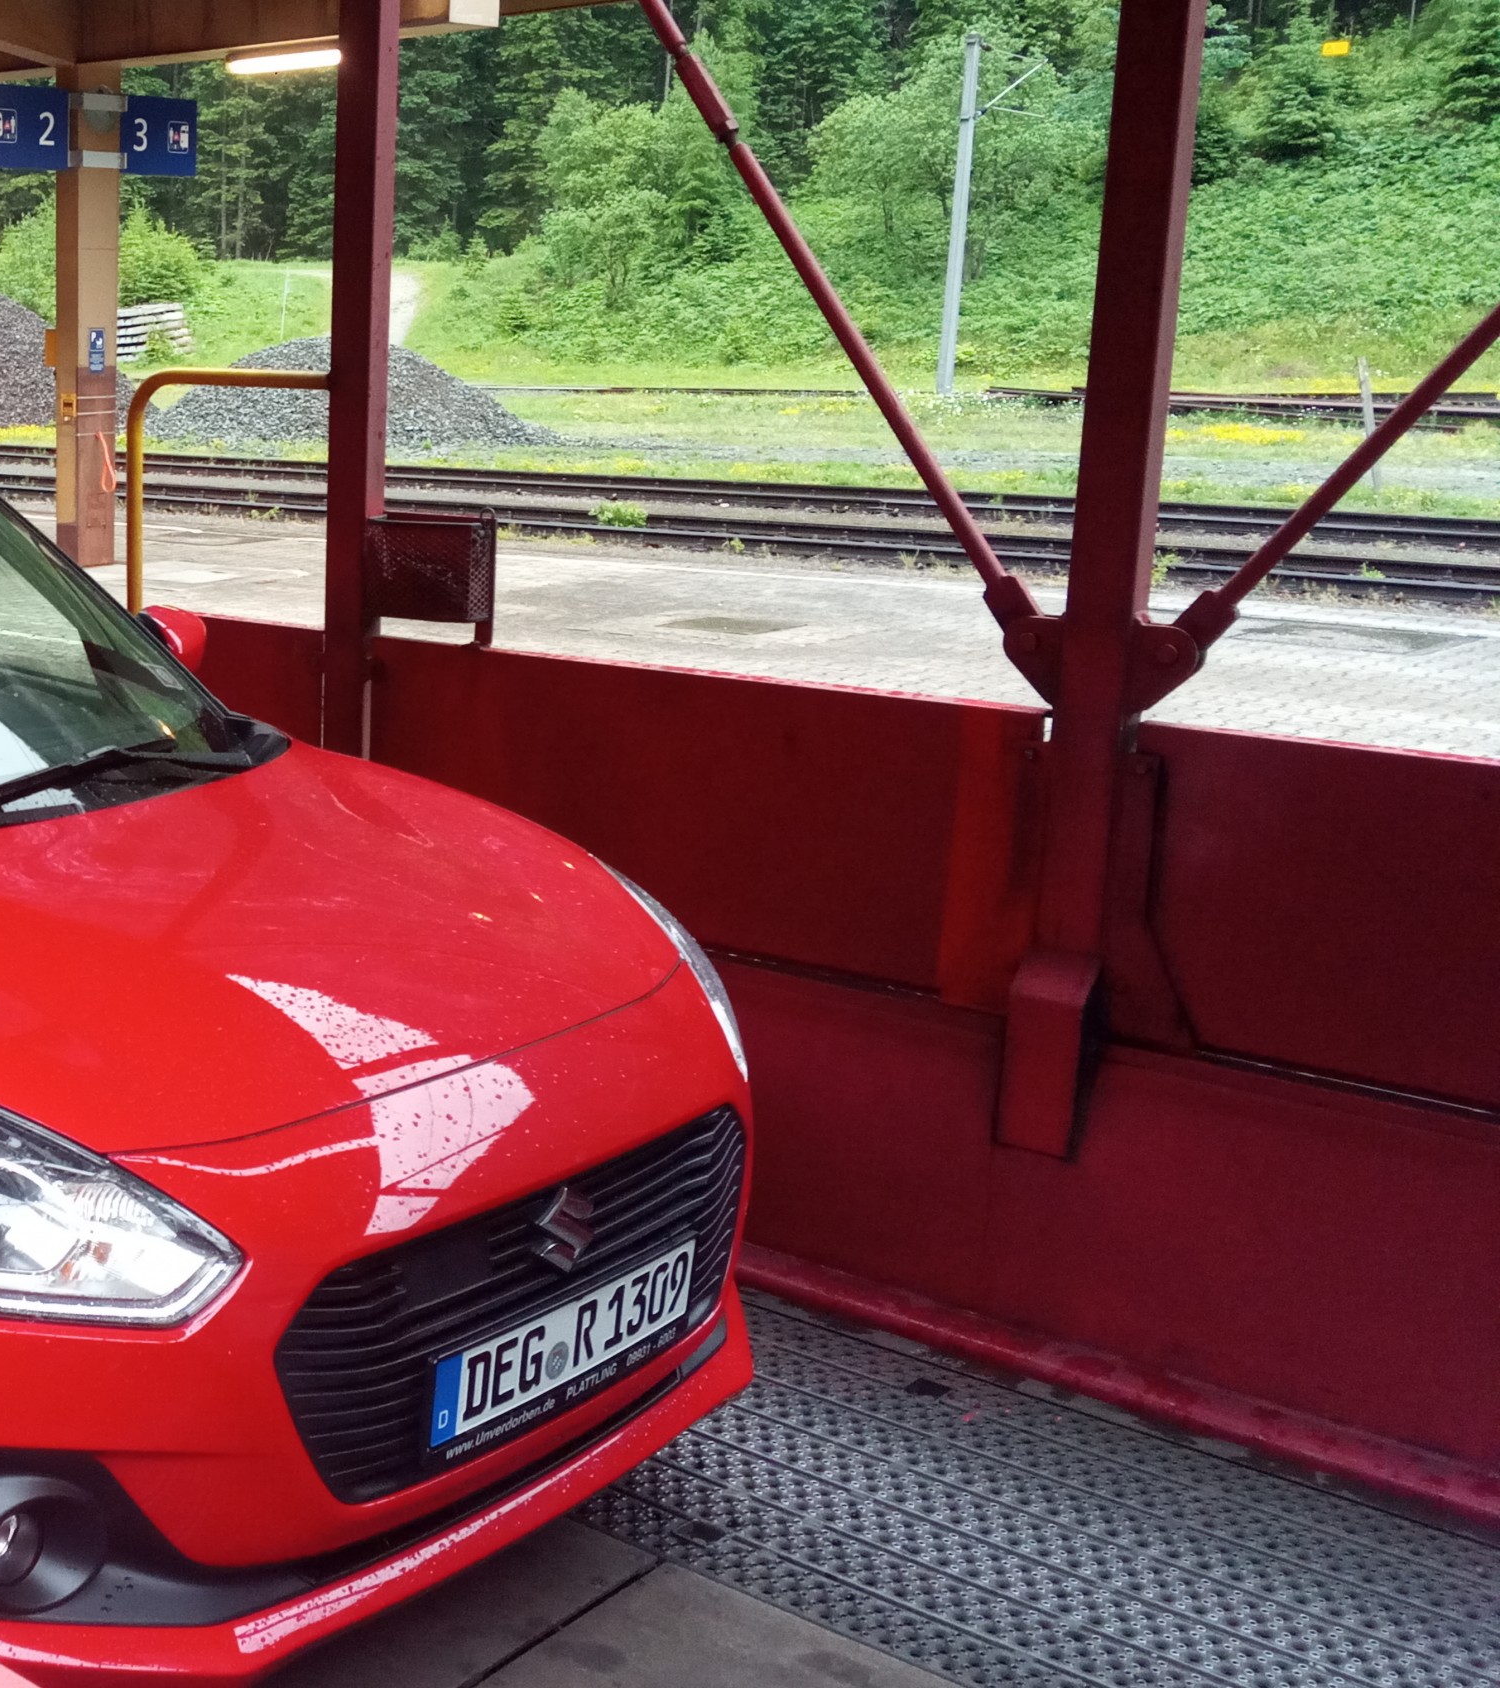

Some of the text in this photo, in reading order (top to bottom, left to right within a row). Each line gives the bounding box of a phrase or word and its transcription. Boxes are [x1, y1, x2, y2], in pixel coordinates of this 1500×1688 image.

[38, 111, 56, 146] 2
[132, 118, 148, 152] 3
[461, 1250, 690, 1423] DEG R 1309
[437, 1409, 449, 1430] D
[445, 1397, 556, 1460] www.Unverdorben.de
[565, 1362, 618, 1401] PLATTLING
